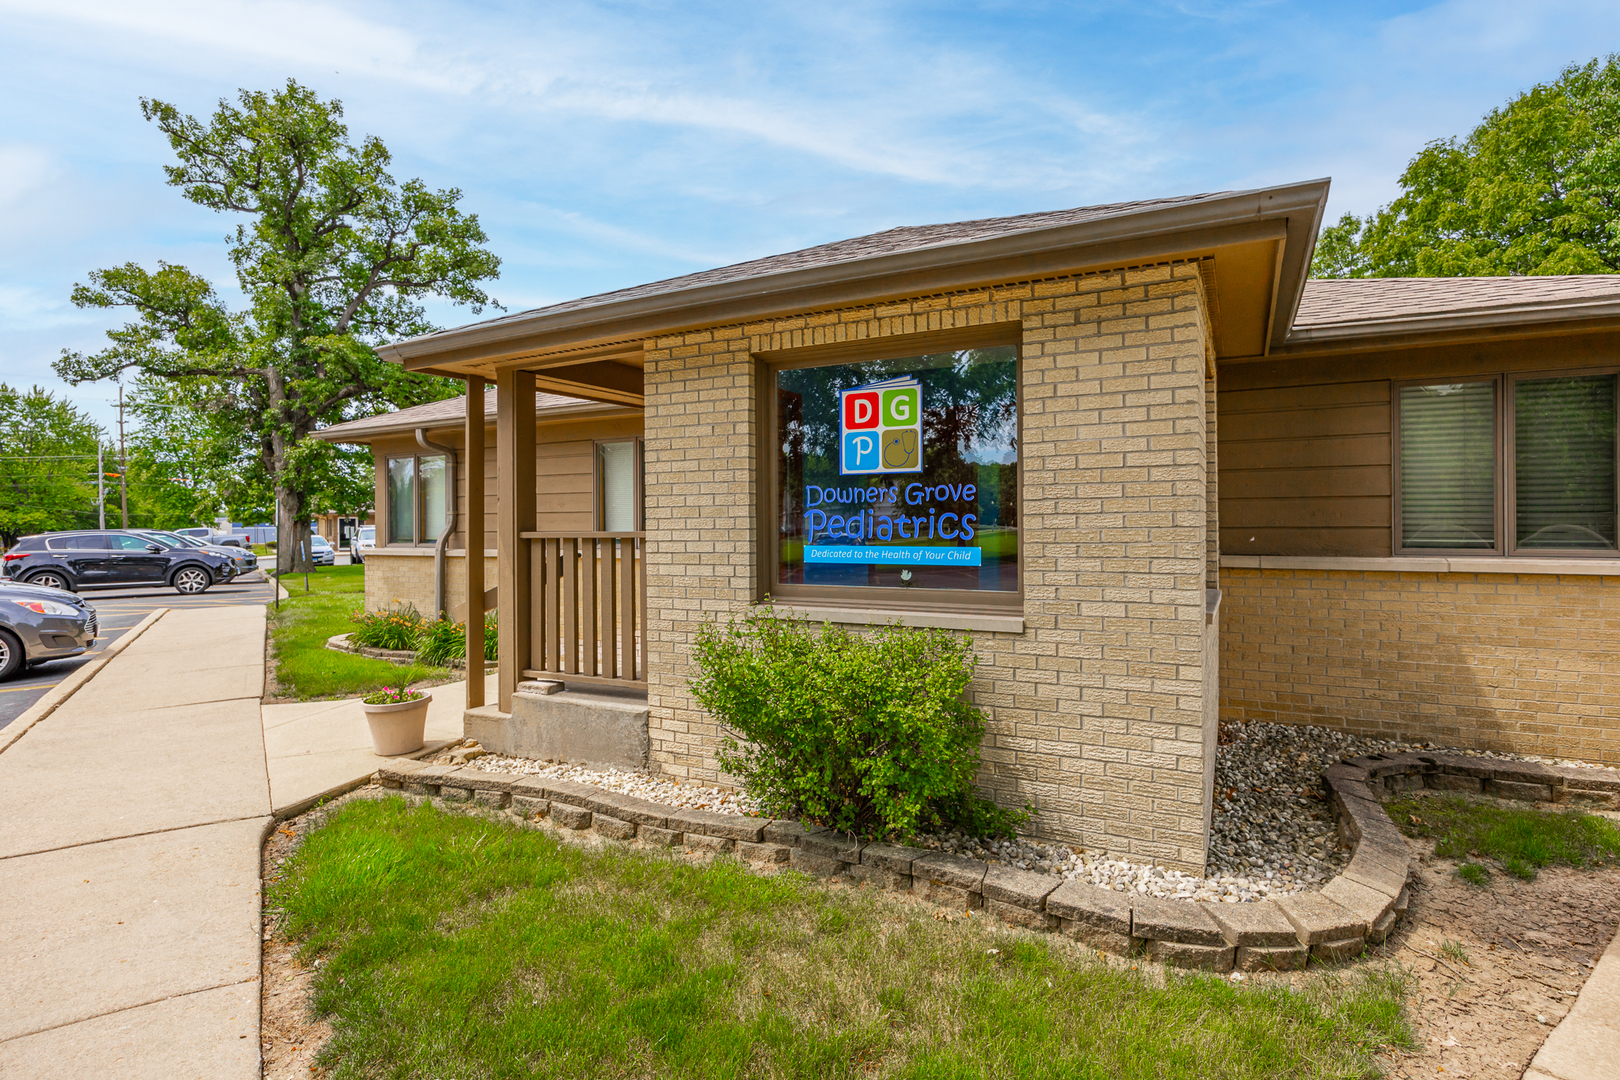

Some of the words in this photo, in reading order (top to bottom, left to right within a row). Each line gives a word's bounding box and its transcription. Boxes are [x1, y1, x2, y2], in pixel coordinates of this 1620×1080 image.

[854, 399, 872, 424] D
[890, 395, 910, 420] G
[852, 436, 873, 465] P
[805, 485, 898, 507] Downers
[904, 482, 976, 505] Grove
[803, 508, 977, 543] Pediatrics
[811, 549, 852, 558] Dedicated
[854, 550, 863, 559] to
[865, 550, 880, 559] the
[881, 550, 911, 559] Health
[913, 550, 924, 562] of
[925, 551, 945, 560] Your
[947, 551, 972, 560] Child
